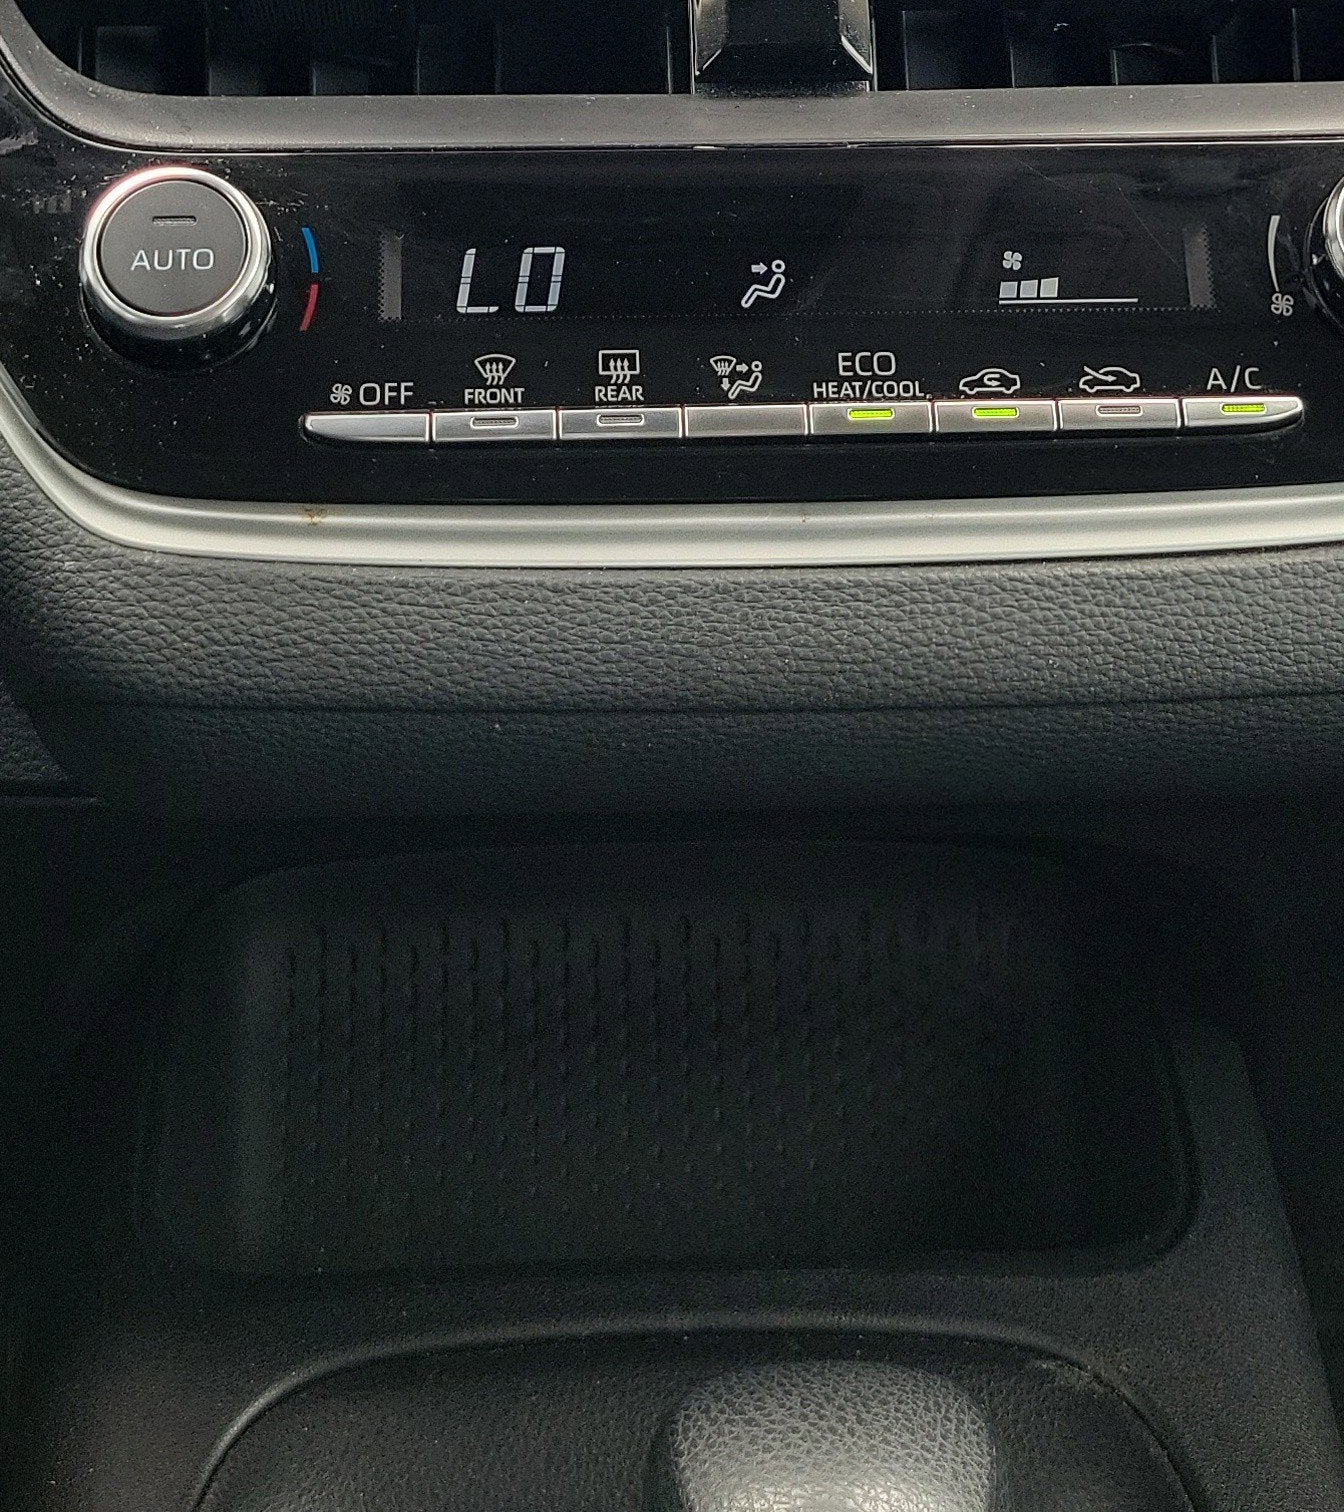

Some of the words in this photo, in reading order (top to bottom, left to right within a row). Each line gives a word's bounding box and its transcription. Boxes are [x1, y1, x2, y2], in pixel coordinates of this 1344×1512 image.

[131, 249, 213, 270] AUTO
[457, 247, 565, 313] LO
[838, 352, 895, 375] ECO
[814, 381, 924, 398] HEAT/COOL
[1207, 366, 1261, 392] A/C
[360, 383, 413, 405] OFF
[465, 388, 524, 404] FRONT
[595, 386, 643, 401] REAR
